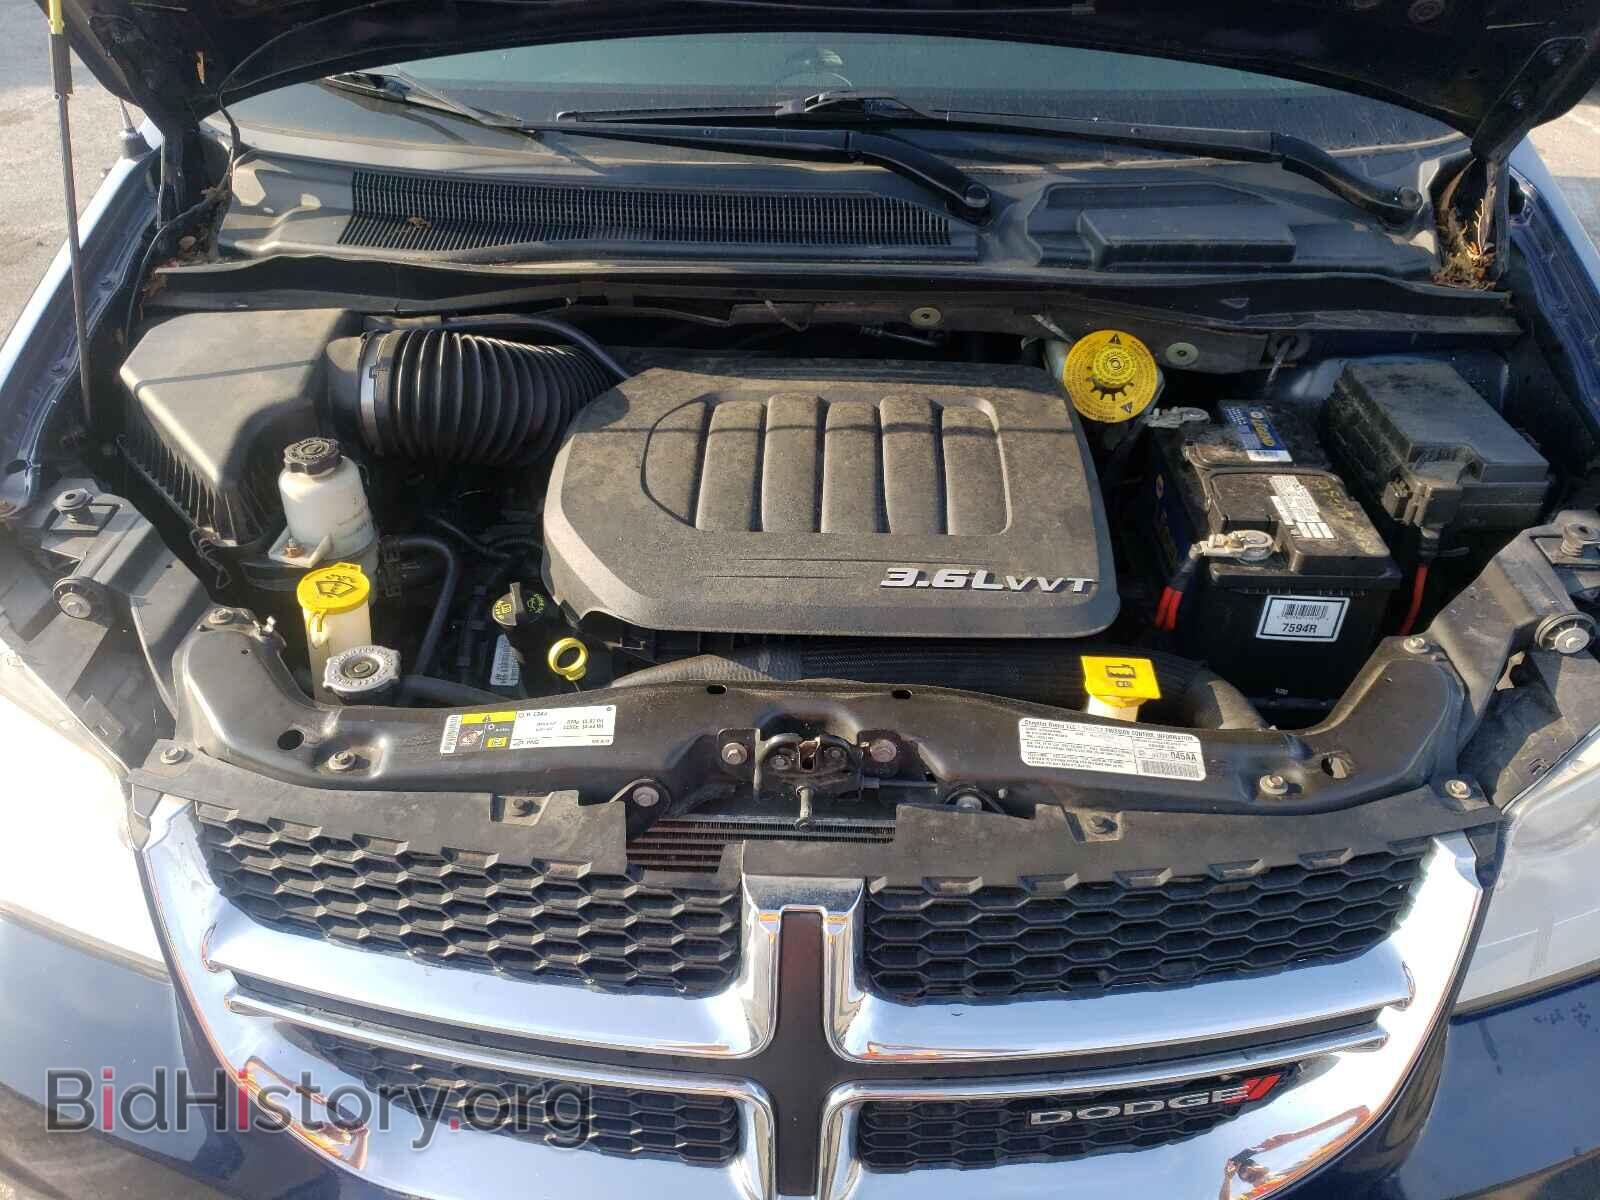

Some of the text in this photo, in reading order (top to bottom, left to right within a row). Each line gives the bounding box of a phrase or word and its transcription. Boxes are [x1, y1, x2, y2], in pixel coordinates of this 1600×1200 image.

[1005, 575, 1096, 592] VVT
[1281, 622, 1318, 633] 7594R
[1030, 1086, 1250, 1126] DODGE
